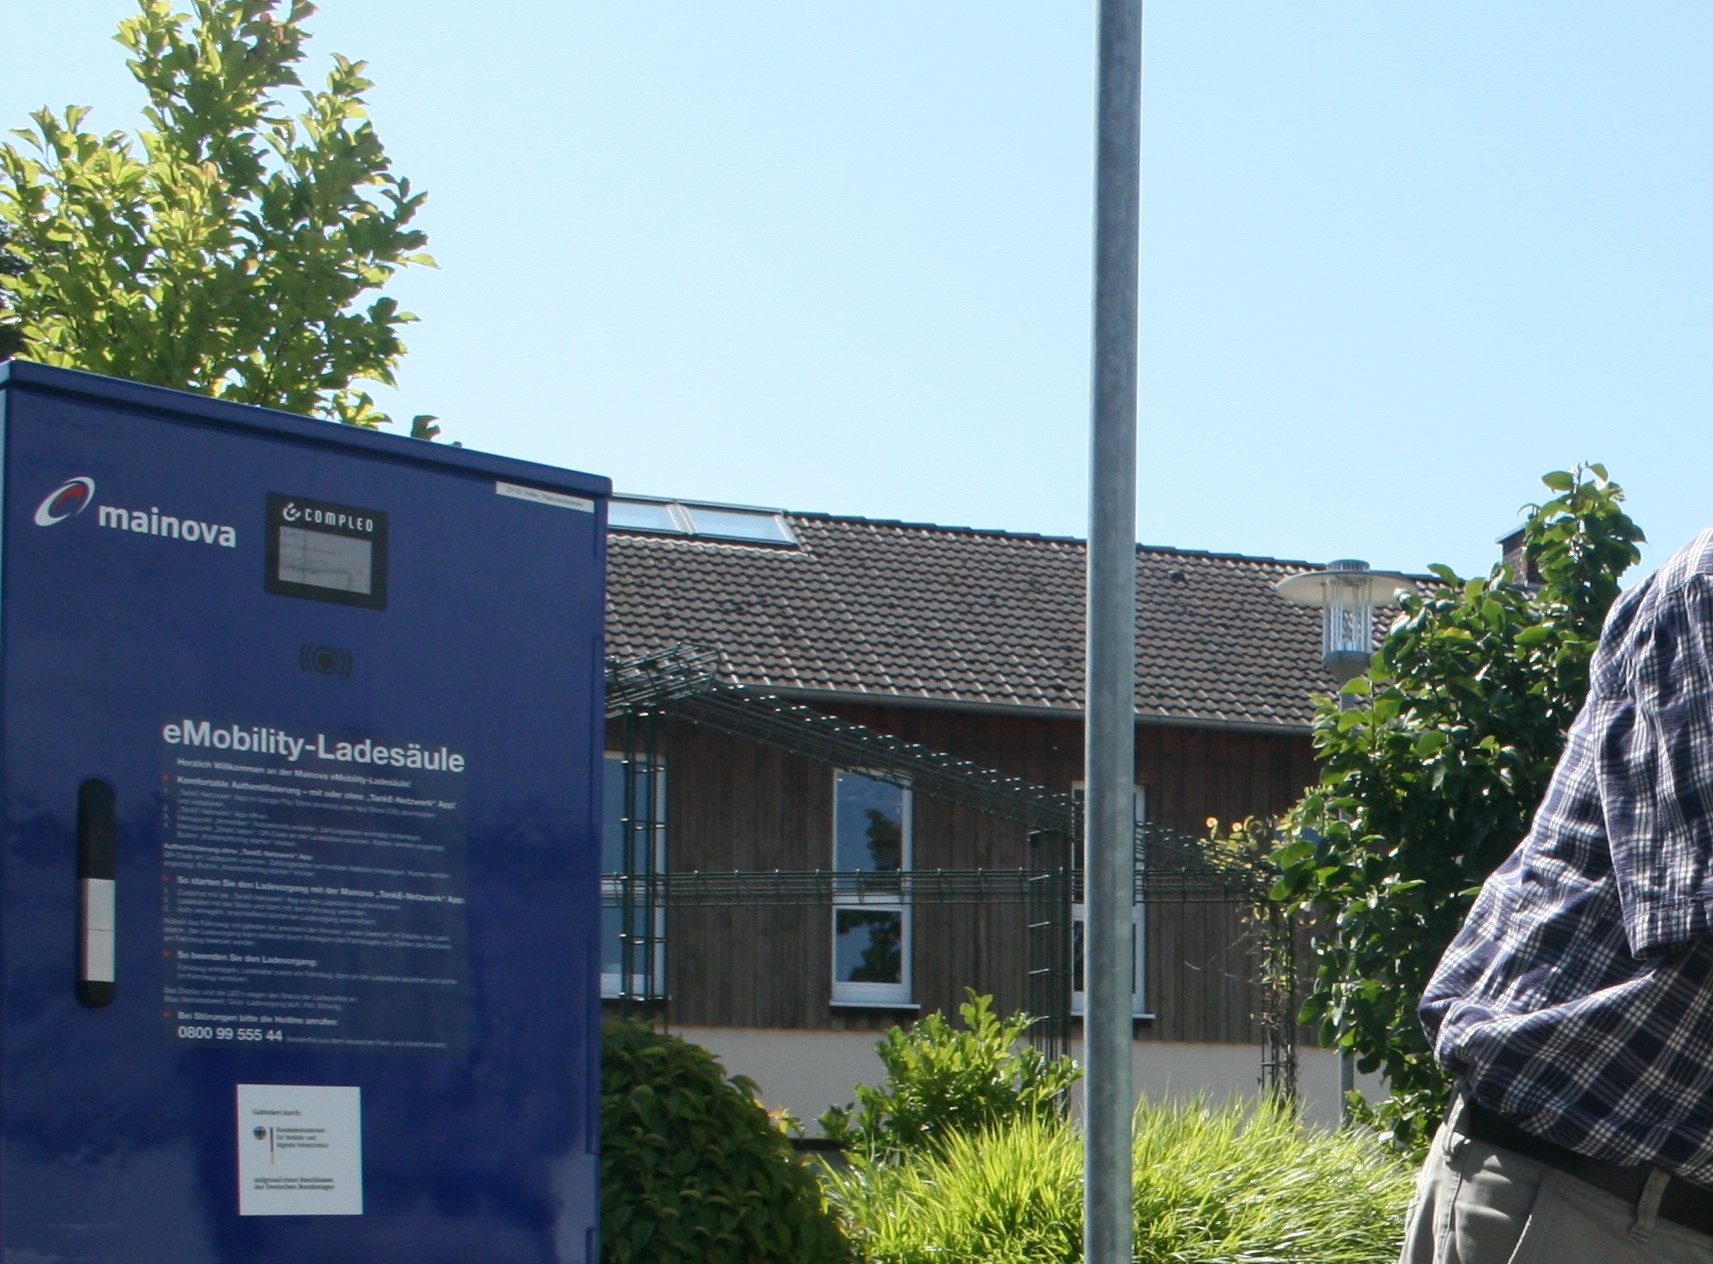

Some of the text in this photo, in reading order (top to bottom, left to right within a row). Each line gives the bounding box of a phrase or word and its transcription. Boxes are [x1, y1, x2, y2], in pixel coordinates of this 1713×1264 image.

[99, 505, 236, 547] mainova
[305, 508, 374, 532] COMPLEO
[163, 719, 465, 772] eMobility-Ladesäule
[178, 1026, 213, 1040] 0800
[216, 1027, 234, 1040] 99
[237, 1028, 263, 1041] 555
[266, 1029, 283, 1042] 44
